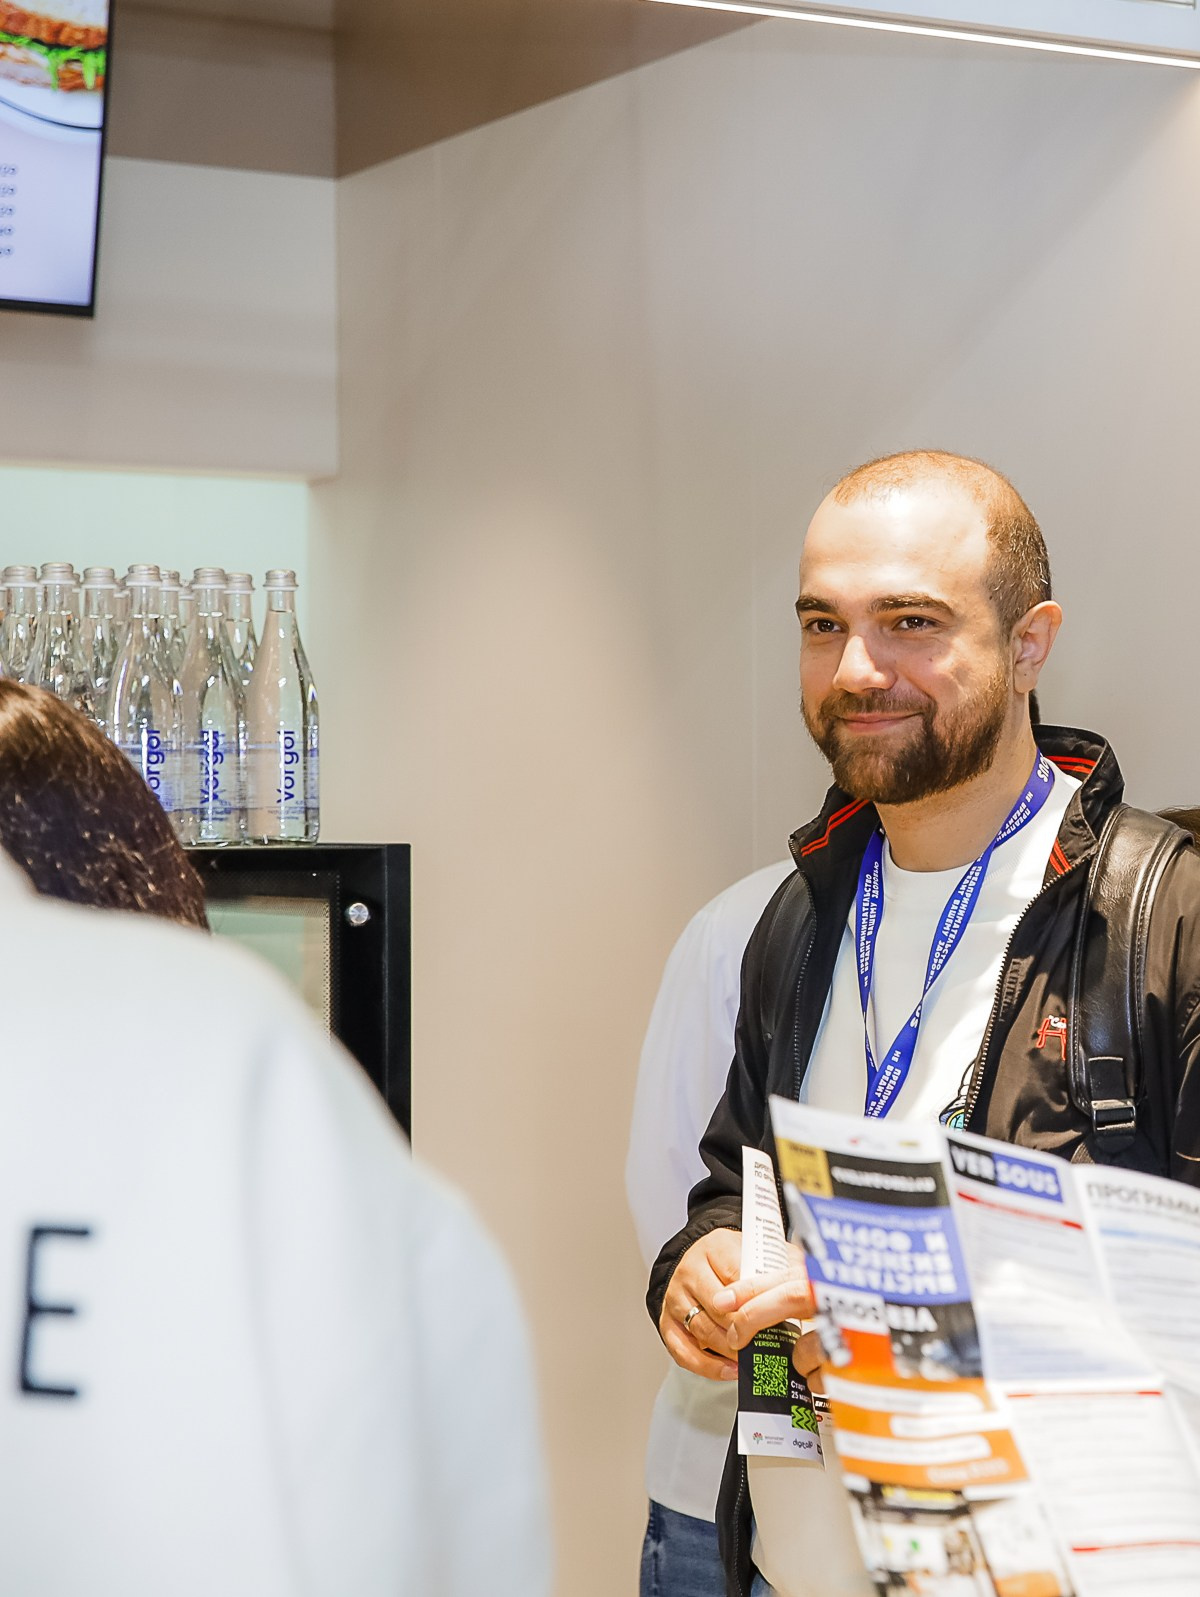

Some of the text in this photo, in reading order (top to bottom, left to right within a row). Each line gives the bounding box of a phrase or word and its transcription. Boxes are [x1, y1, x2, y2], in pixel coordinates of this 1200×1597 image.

[860, 873, 872, 975] ПРЕДПРИНИМАТЕЛЬСТВО
[866, 901, 878, 936] ВАШЕМУ
[935, 866, 982, 970] ПРЕДПРИНИМАТЕЛЬСТВО
[19, 1225, 91, 1398] E
